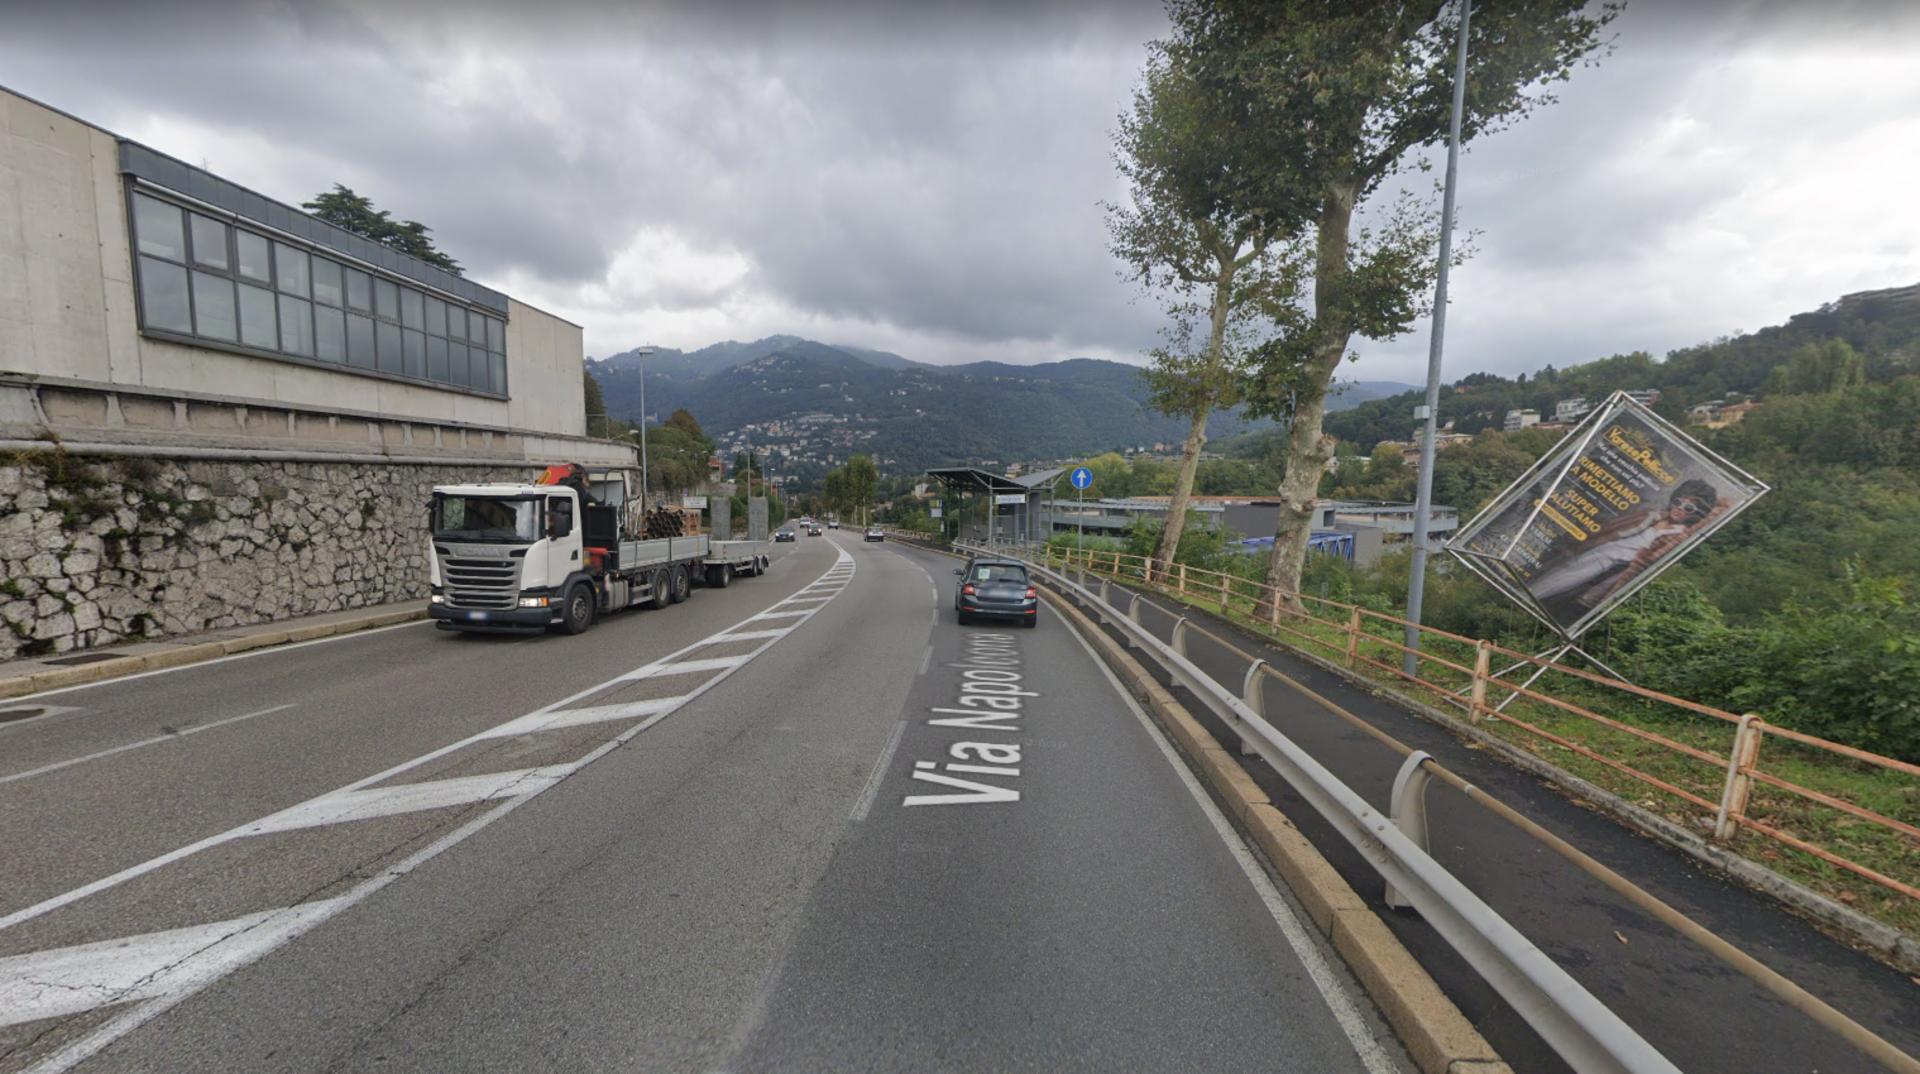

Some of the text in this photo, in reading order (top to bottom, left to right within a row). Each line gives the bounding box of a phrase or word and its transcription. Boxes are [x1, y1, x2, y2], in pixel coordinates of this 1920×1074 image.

[1570, 465, 1629, 511] A MODELLO
[1577, 455, 1640, 504] RIMETTIAMO
[1550, 491, 1601, 533] ALUTIAMO
[1565, 489, 1599, 516] SUPER
